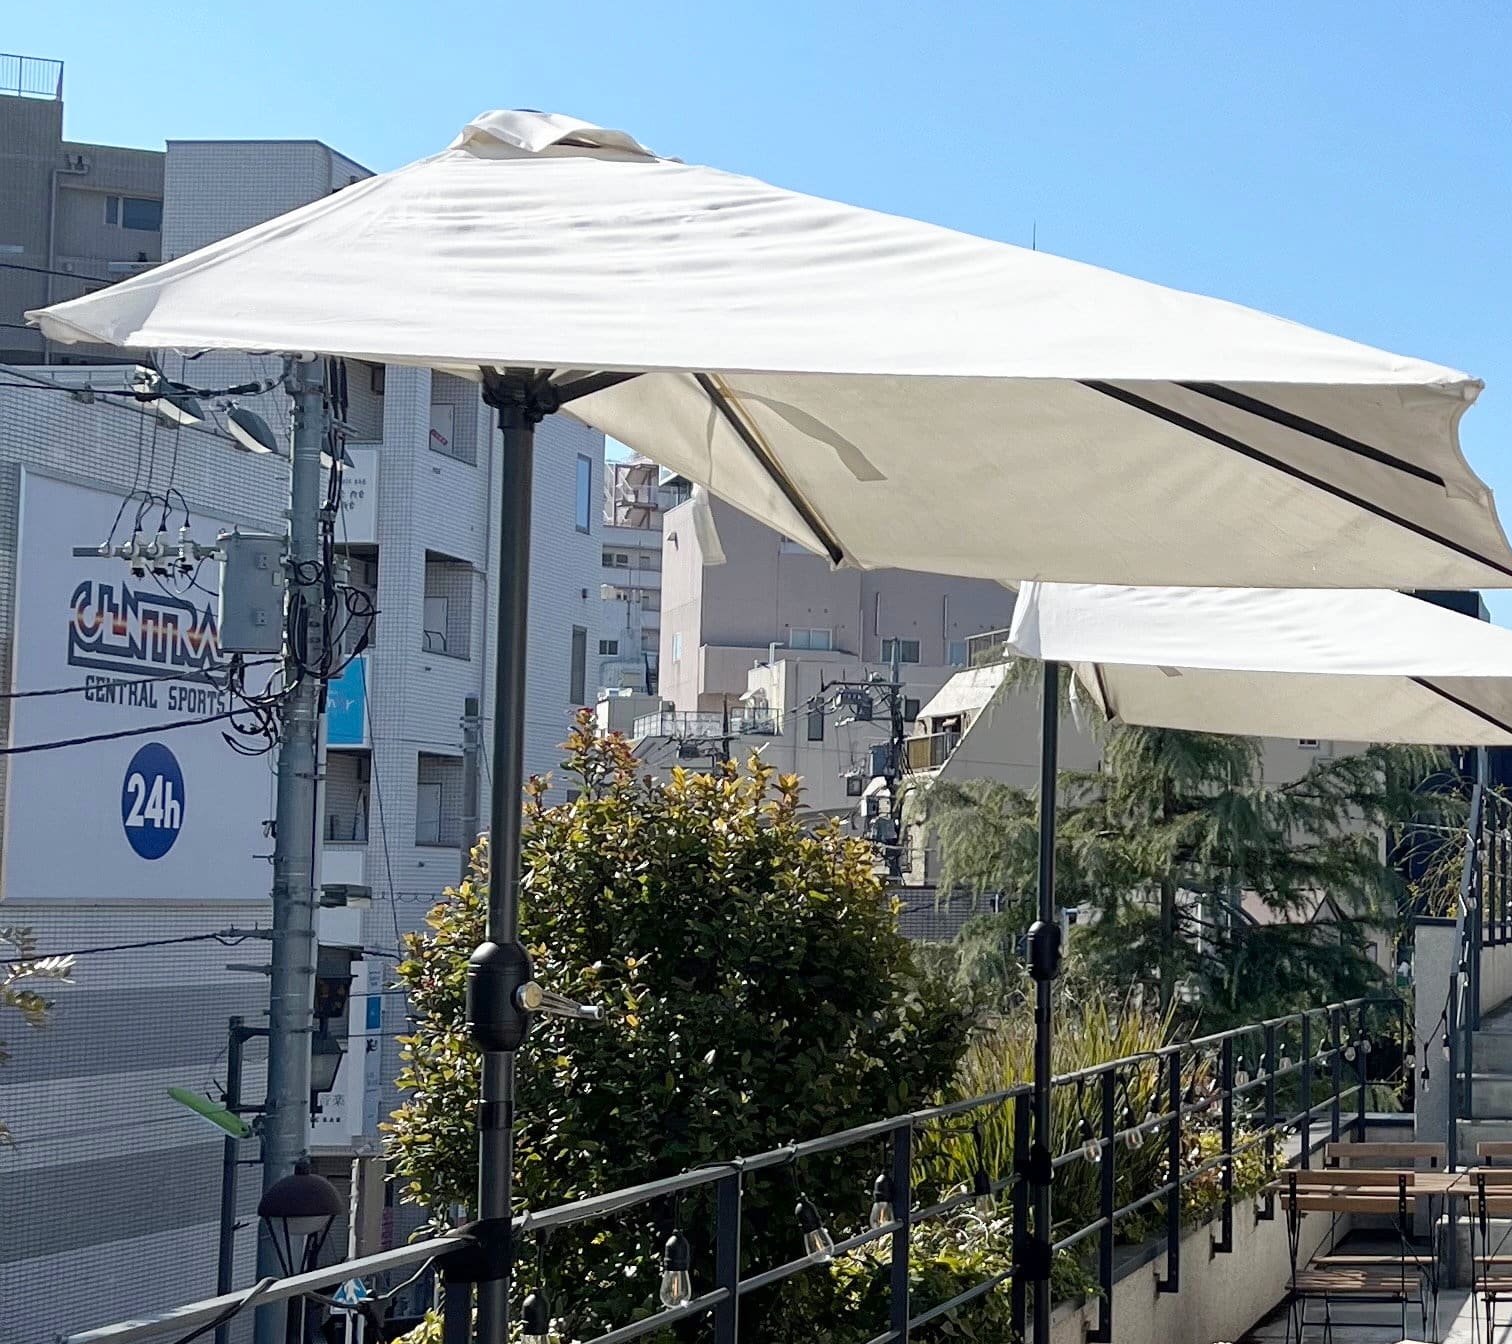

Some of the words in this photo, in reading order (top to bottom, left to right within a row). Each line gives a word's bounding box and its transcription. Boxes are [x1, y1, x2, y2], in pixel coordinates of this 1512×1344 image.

[85, 674, 158, 709] CENTRAL
[167, 685, 226, 716] SPORTS
[125, 772, 181, 829] 24h
